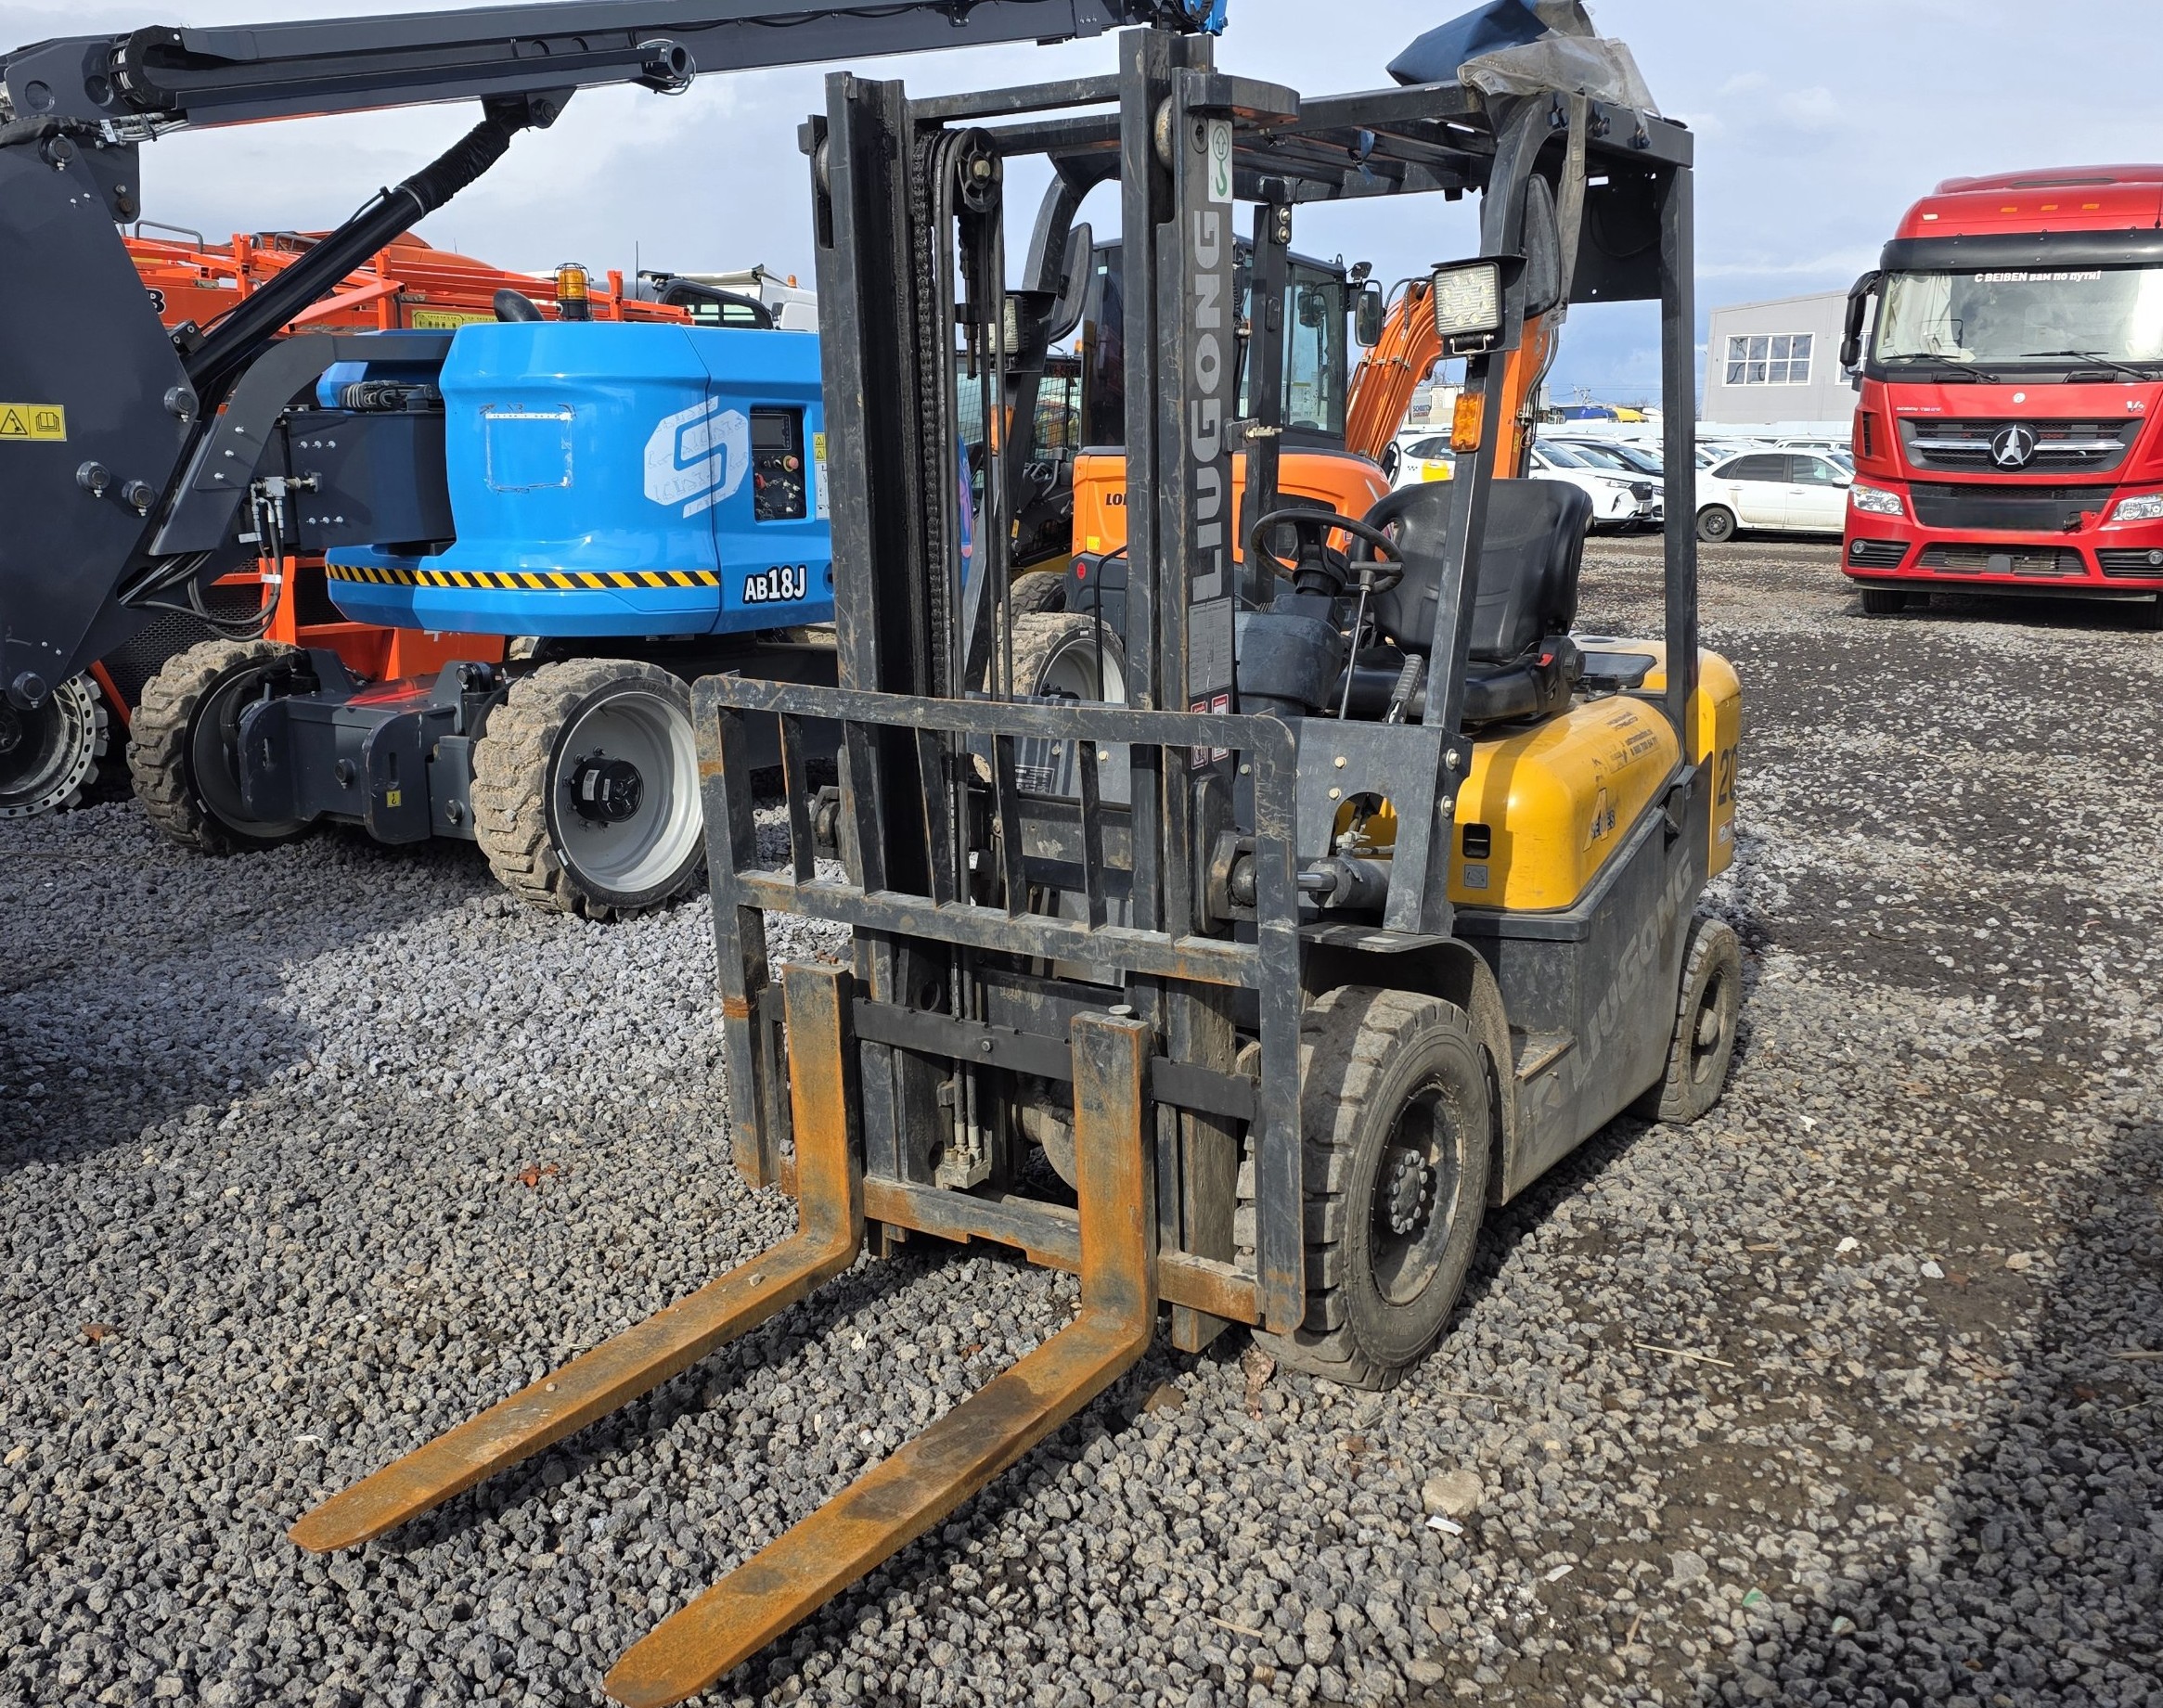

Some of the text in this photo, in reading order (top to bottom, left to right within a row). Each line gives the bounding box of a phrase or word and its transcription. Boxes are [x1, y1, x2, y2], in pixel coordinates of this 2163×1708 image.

[1984, 272, 2028, 282] BEIBEN
[2029, 273, 2052, 281] вам
[2053, 273, 2068, 281] по
[2069, 271, 2102, 283] пути!
[1191, 210, 1222, 602] LIUGONG
[743, 565, 806, 603] AB18J
[1570, 847, 1693, 1093] LIUGONG
